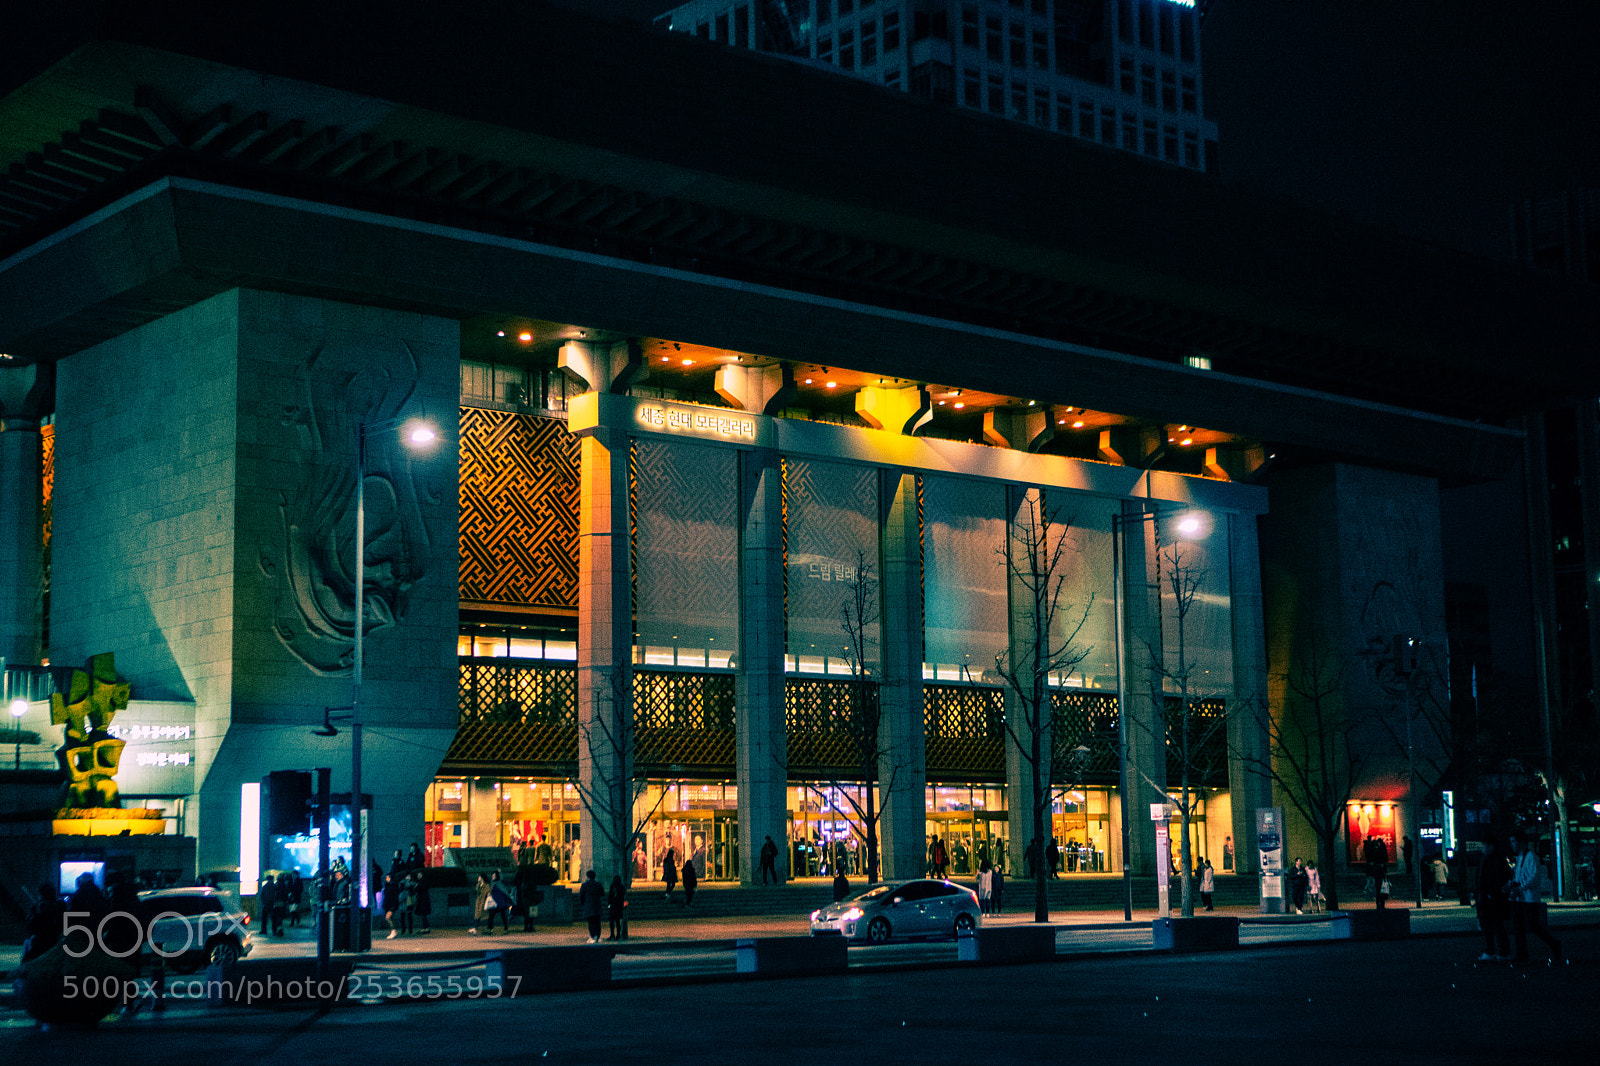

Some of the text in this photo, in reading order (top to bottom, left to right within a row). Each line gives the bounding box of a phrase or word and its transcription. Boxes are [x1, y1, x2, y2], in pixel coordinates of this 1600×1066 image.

[640, 407, 754, 437] 세종 현대 모터갤러리
[808, 563, 831, 582] 드림
